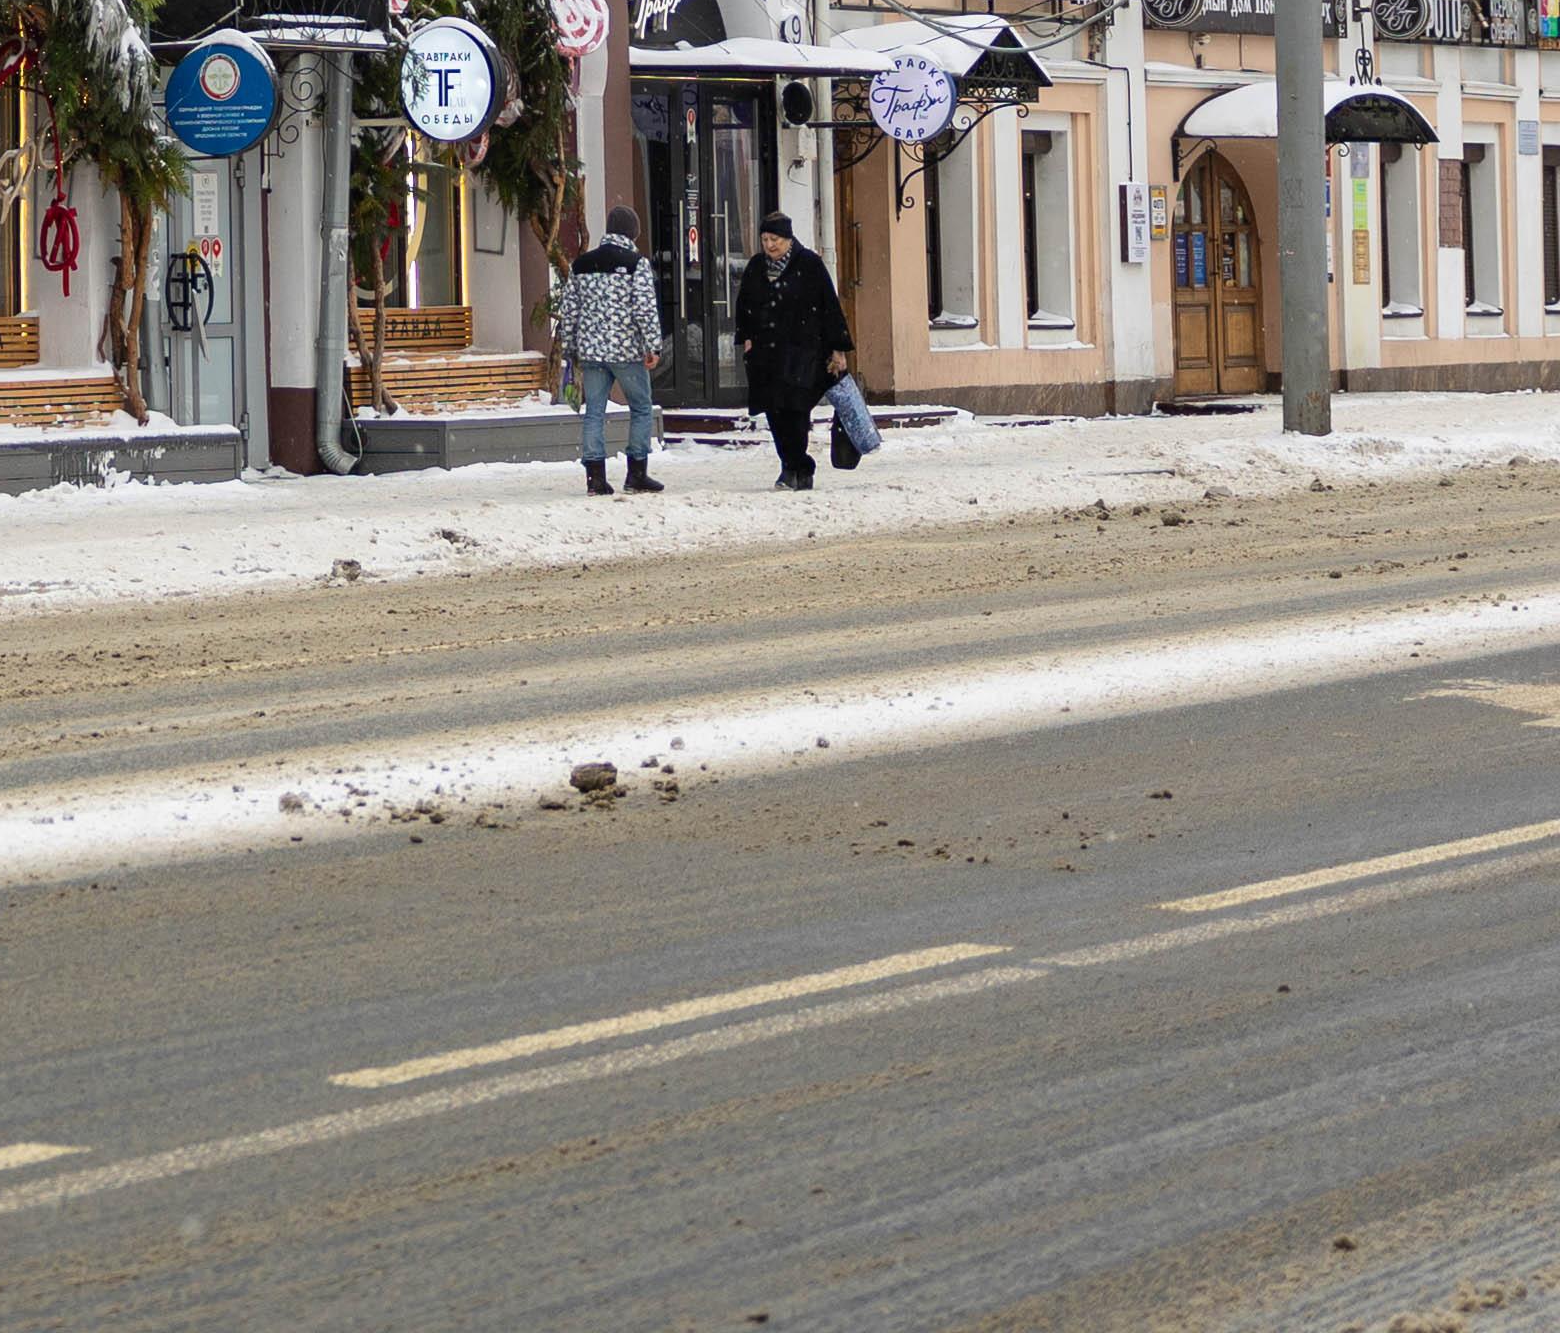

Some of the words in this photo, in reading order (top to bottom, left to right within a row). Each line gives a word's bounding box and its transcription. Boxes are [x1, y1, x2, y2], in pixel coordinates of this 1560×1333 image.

[791, 15, 801, 44] 9
[421, 114, 473, 125] ОБЕДЫ
[894, 127, 925, 139] БАР
